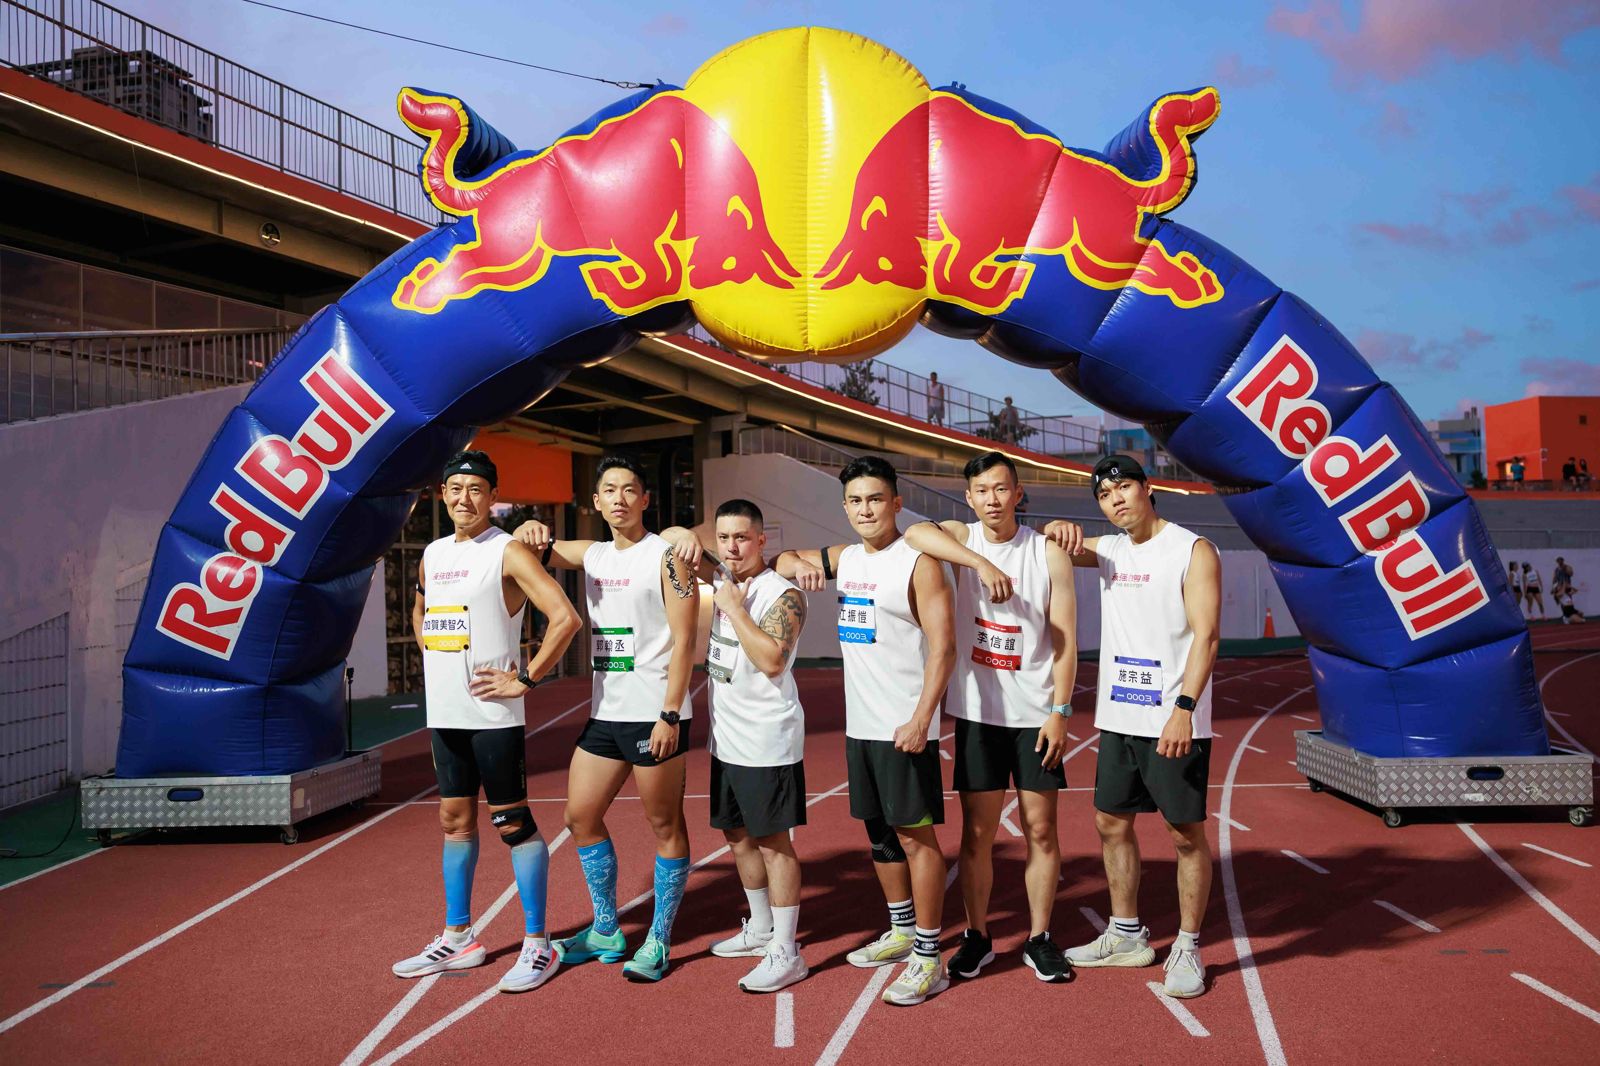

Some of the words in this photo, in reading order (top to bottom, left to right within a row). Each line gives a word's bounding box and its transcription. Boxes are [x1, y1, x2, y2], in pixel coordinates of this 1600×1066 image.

[1229, 337, 1399, 506] Red
[1340, 473, 1488, 638] Bull
[158, 485, 293, 658] Red
[236, 350, 392, 517] Bull
[424, 619, 467, 631] 加賀美智久
[842, 632, 867, 640] 0003
[977, 631, 1016, 651] 李信誼
[602, 661, 625, 669] 0003
[985, 657, 1013, 668] 0003
[1118, 668, 1152, 685] 施宗益
[1126, 692, 1152, 702] 0003
